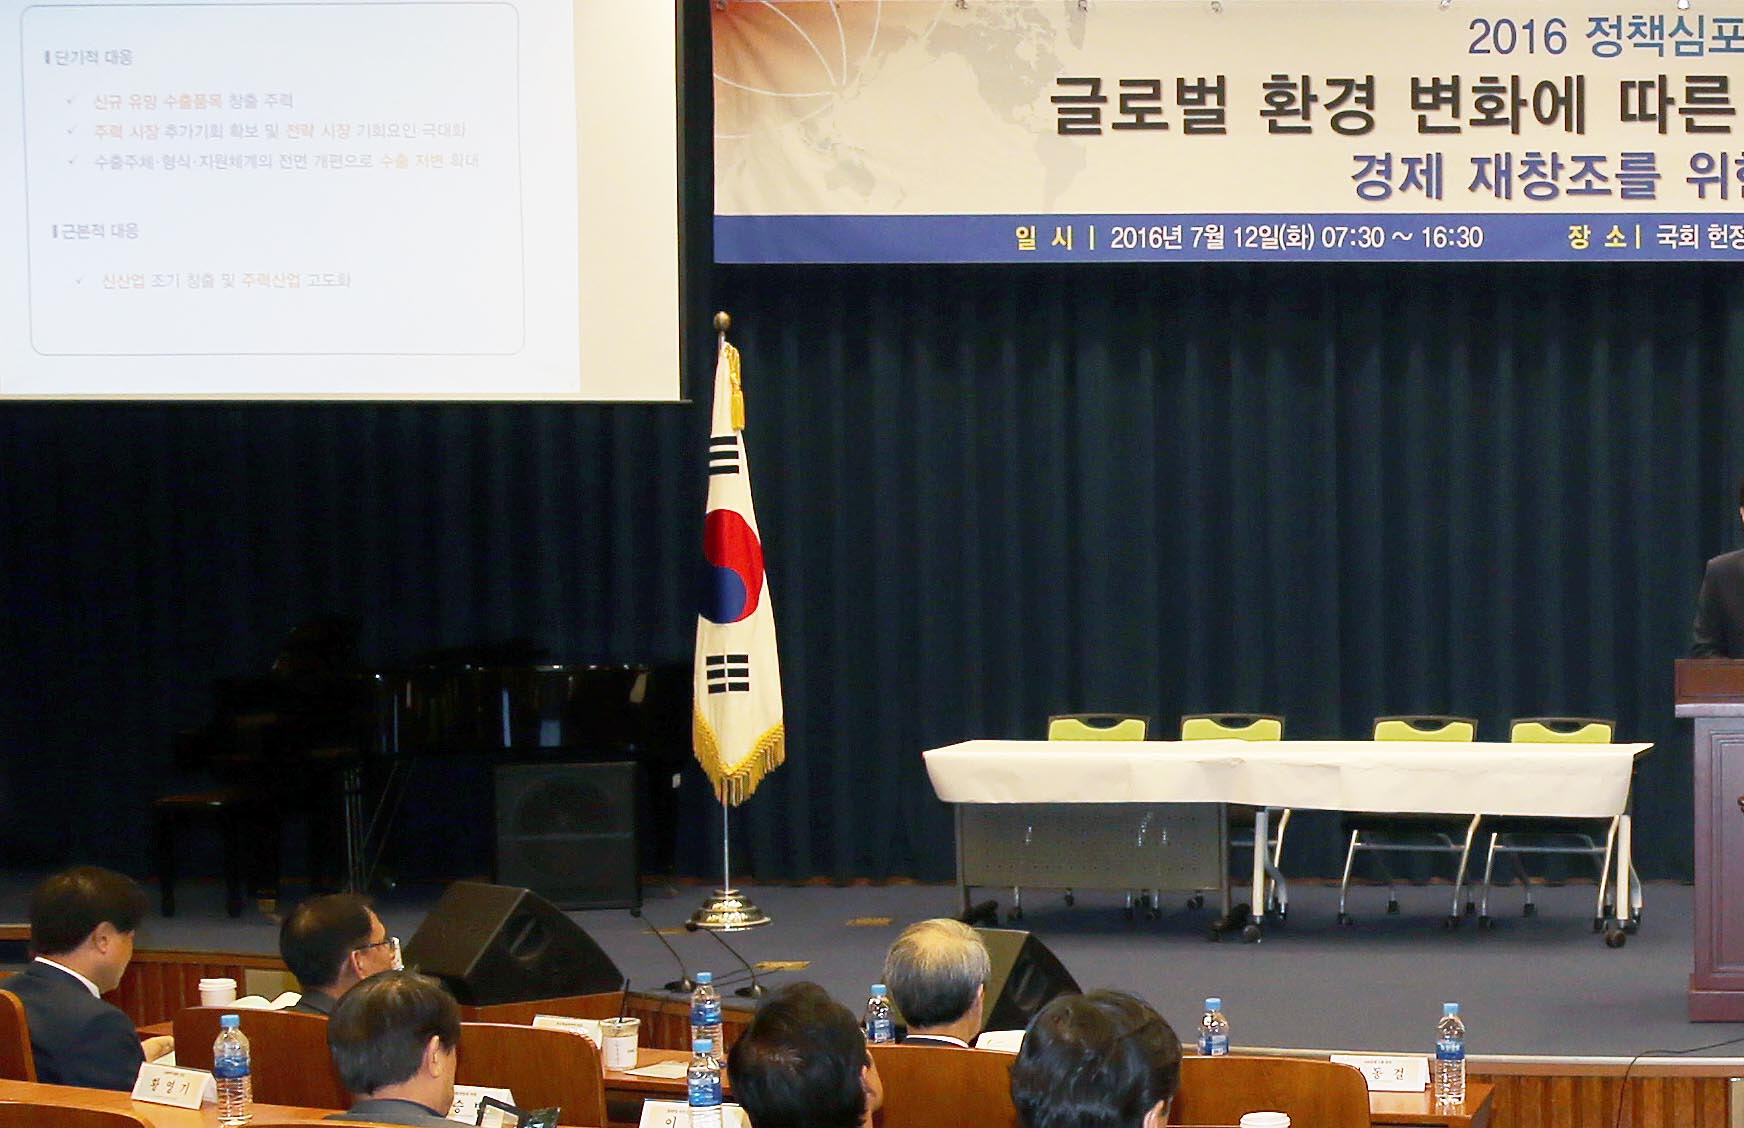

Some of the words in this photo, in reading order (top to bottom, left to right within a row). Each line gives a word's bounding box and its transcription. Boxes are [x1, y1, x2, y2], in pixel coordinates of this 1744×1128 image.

[1469, 18, 1567, 54] 2016
[55, 50, 98, 66] 단기적
[105, 49, 133, 66] 대응
[94, 95, 122, 110] 신규
[129, 94, 157, 110] 유망
[163, 94, 222, 109] 수출품목
[230, 93, 258, 109] 창출
[264, 93, 293, 108] 주력
[1051, 75, 1226, 135] 글로벌
[1260, 75, 1375, 136] 환경
[1411, 75, 1585, 135] 변화에
[1620, 74, 1736, 134] 따른
[94, 125, 123, 140] 주력
[129, 125, 160, 140] 시장
[164, 124, 223, 139] 추가기회
[230, 123, 259, 139] 확보
[265, 123, 278, 139] 및
[286, 123, 314, 139] 전략
[321, 123, 350, 140] 시장
[357, 123, 416, 138] 기회요인
[422, 122, 466, 138] 극대화
[1351, 152, 1442, 201] 경제
[1468, 152, 1661, 201] 재창조를
[62, 224, 104, 239] 근본적
[111, 222, 138, 239] 대응
[1016, 226, 1035, 250] 일
[1052, 226, 1072, 250] 시
[1111, 225, 1182, 249] 2016년
[1191, 225, 1224, 249] 7월
[1234, 224, 1314, 250] 12일(화)
[1322, 226, 1384, 248] 07:30
[1423, 226, 1483, 248] 16:30
[1568, 225, 1591, 249] 장
[1605, 225, 1627, 247] 소
[1657, 224, 1698, 249] 국회
